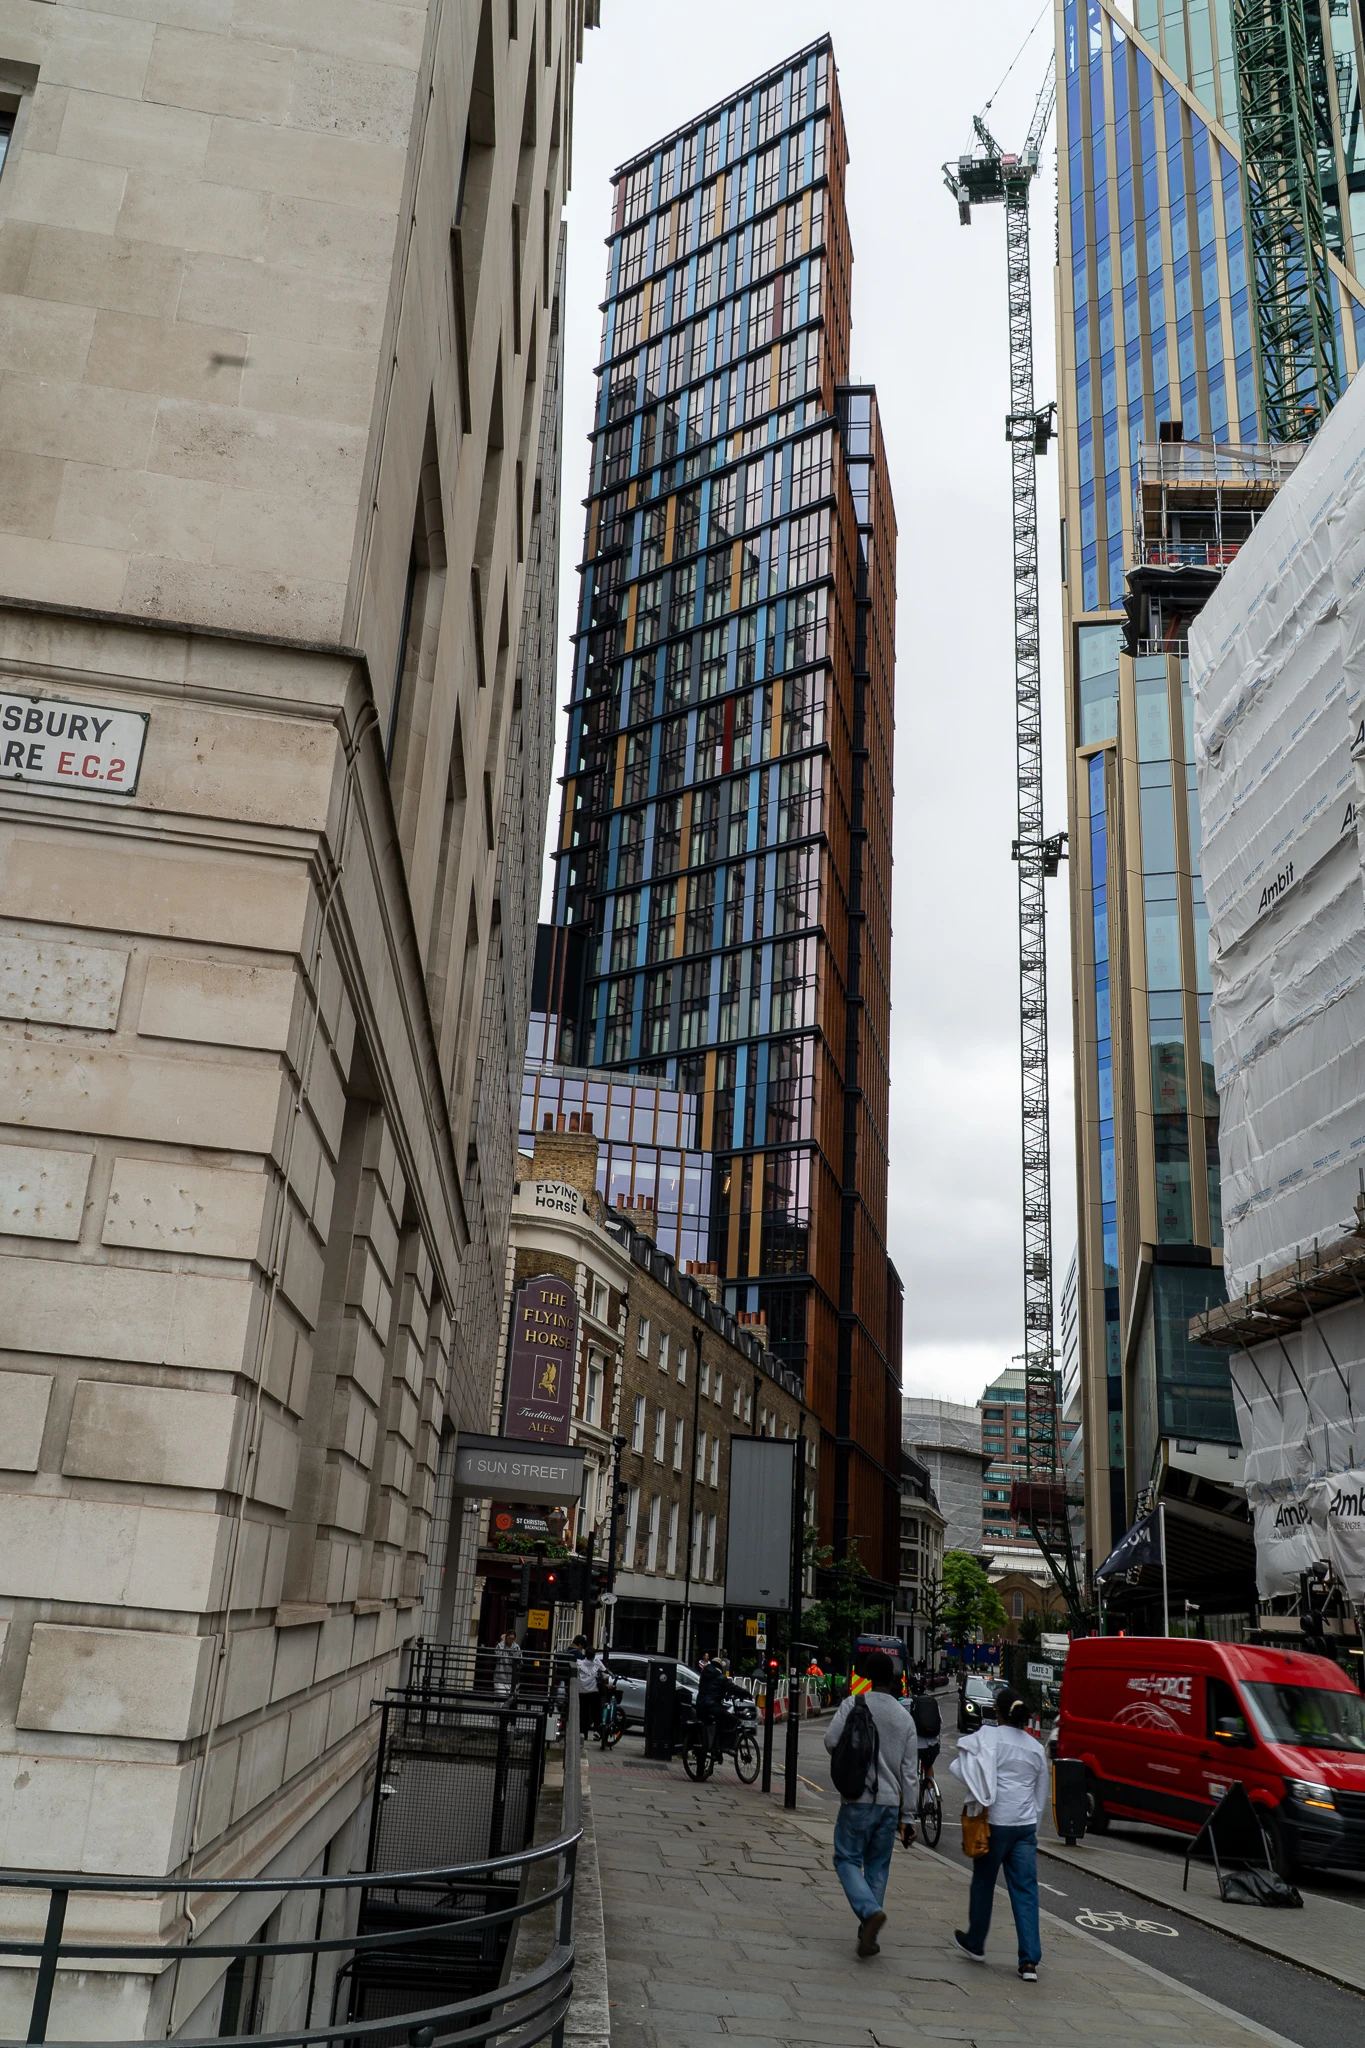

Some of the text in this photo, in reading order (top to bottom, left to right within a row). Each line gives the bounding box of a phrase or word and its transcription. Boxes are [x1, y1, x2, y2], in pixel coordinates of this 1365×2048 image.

[0, 704, 113, 743] SBURY
[0, 740, 126, 782] RE E.C.2
[1258, 861, 1294, 914] Ambit
[536, 1184, 578, 1203] FLYING
[535, 1196, 577, 1215] HORSE
[540, 1290, 567, 1308] THE
[523, 1308, 574, 1331] FLYING
[524, 1329, 571, 1351] HORSE
[516, 1406, 565, 1423] Traditional
[528, 1421, 556, 1434] ALES
[466, 1459, 568, 1480] 1 SUN STREET
[1031, 1665, 1044, 1674] GATE
